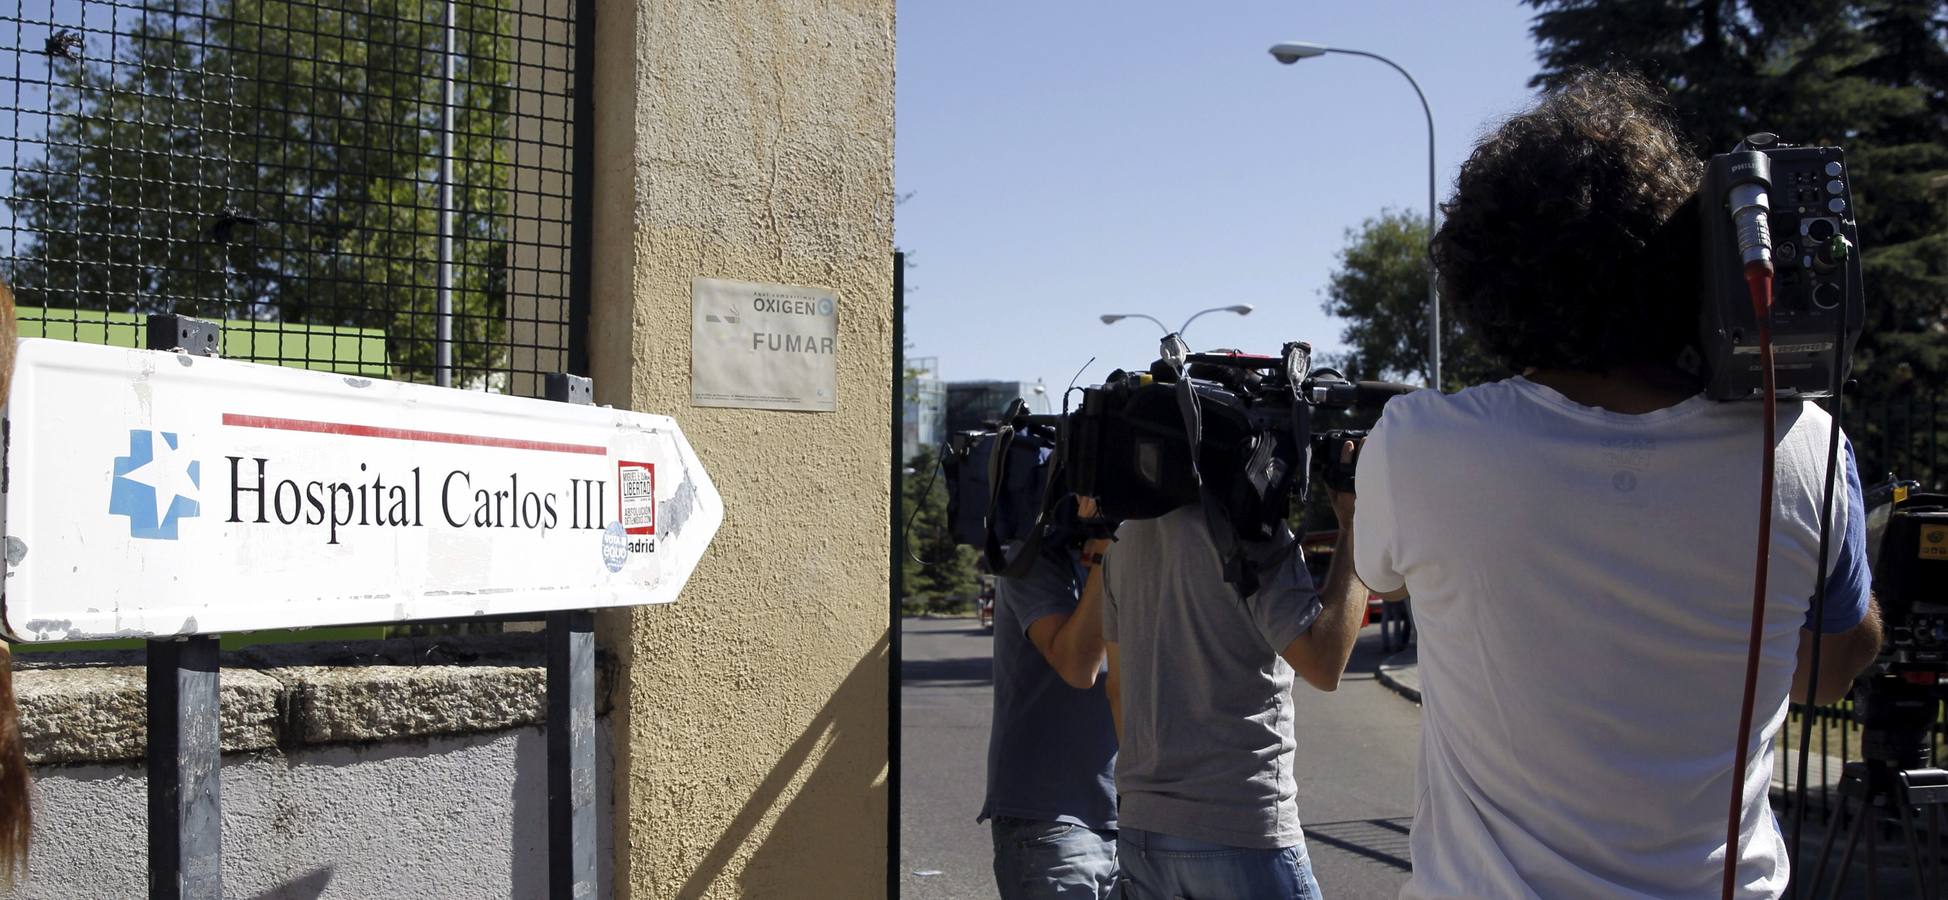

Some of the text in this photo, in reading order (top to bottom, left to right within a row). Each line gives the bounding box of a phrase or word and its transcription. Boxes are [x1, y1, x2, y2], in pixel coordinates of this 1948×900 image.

[753, 332, 833, 355] FUMAR
[624, 481, 651, 496] LIBERTAD
[224, 456, 607, 545] Hospital Carlos III
